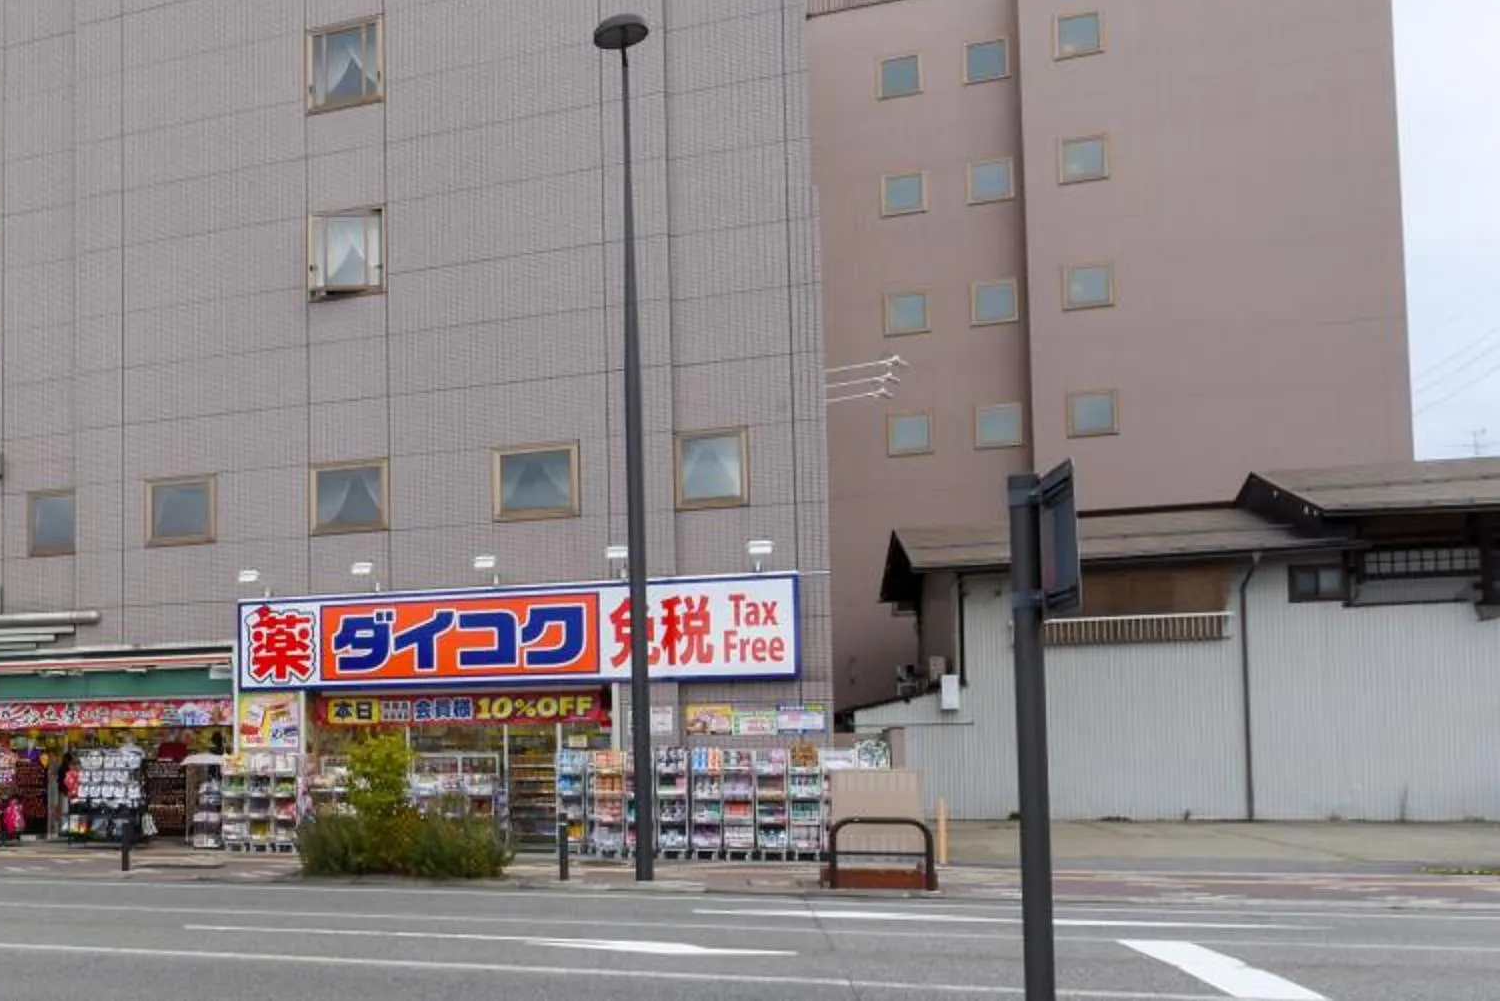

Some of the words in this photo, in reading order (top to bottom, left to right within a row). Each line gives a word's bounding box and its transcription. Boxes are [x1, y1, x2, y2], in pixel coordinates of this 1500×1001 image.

[727, 593, 778, 626] Tax
[250, 604, 313, 681] 薬
[332, 603, 586, 674] ダイコク
[722, 630, 786, 663] Free
[334, 700, 373, 720] 本日
[476, 695, 593, 719] 10%OFF
